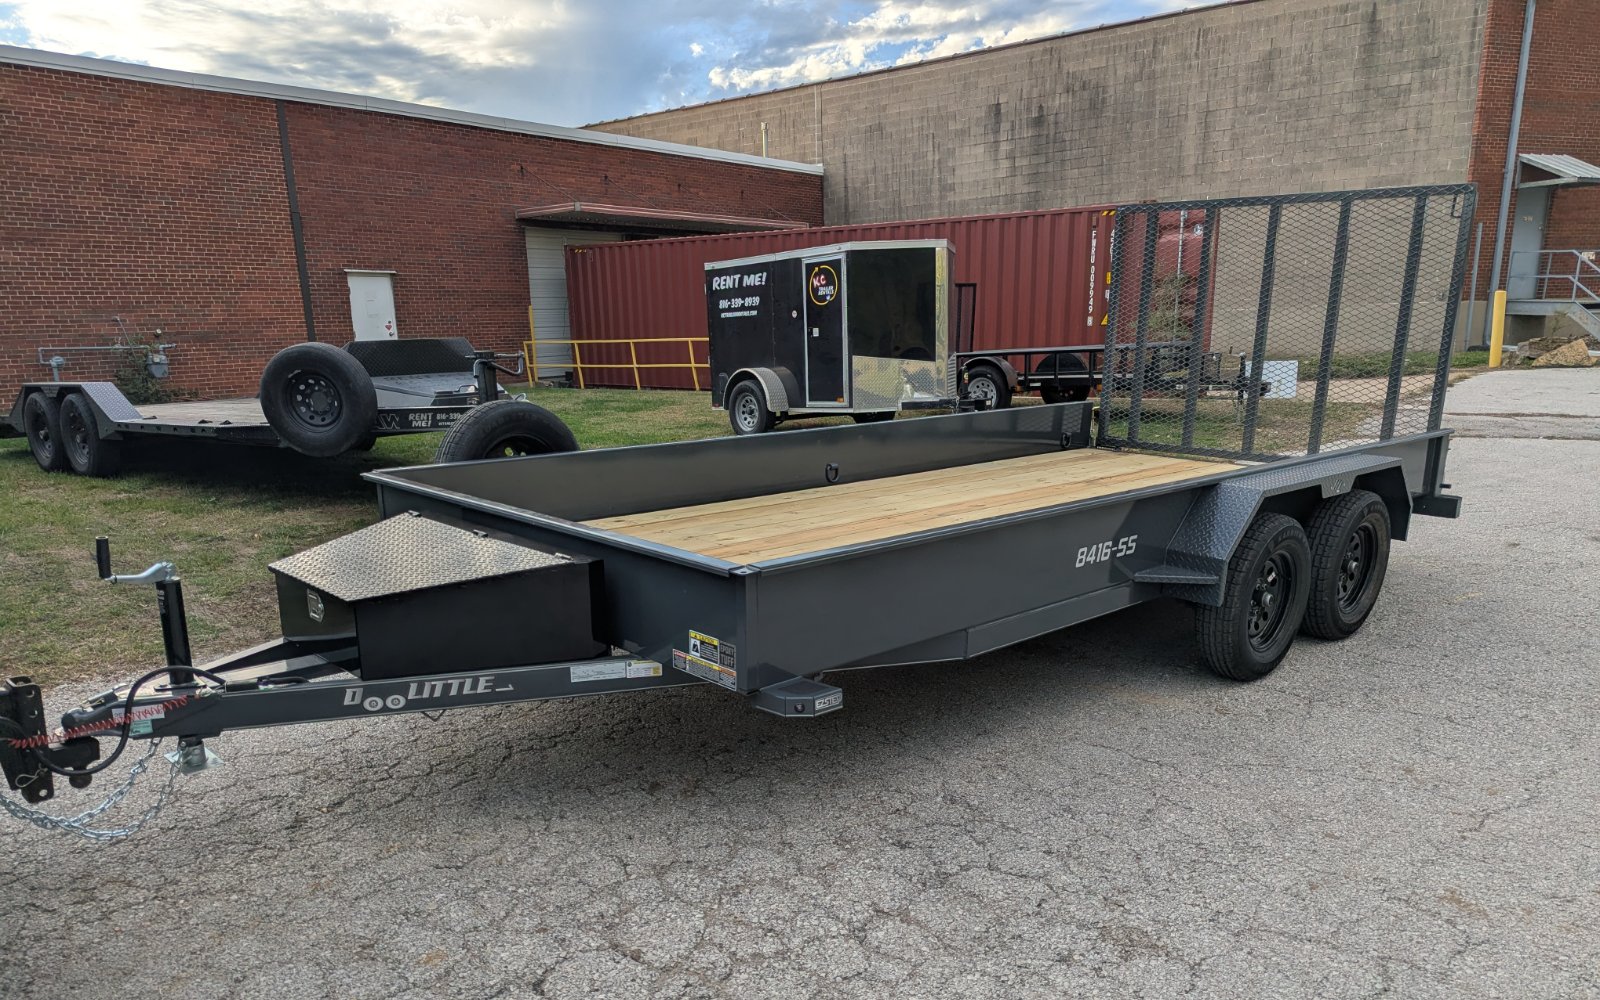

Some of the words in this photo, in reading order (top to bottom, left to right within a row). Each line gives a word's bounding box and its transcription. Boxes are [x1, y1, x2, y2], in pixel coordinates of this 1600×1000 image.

[712, 274, 741, 291] RENT
[742, 271, 767, 287] ME!
[813, 274, 827, 288] KC
[718, 296, 760, 309] 816-339-8939
[408, 412, 434, 421] RENT
[343, 676, 496, 712] DOOLITTLE
